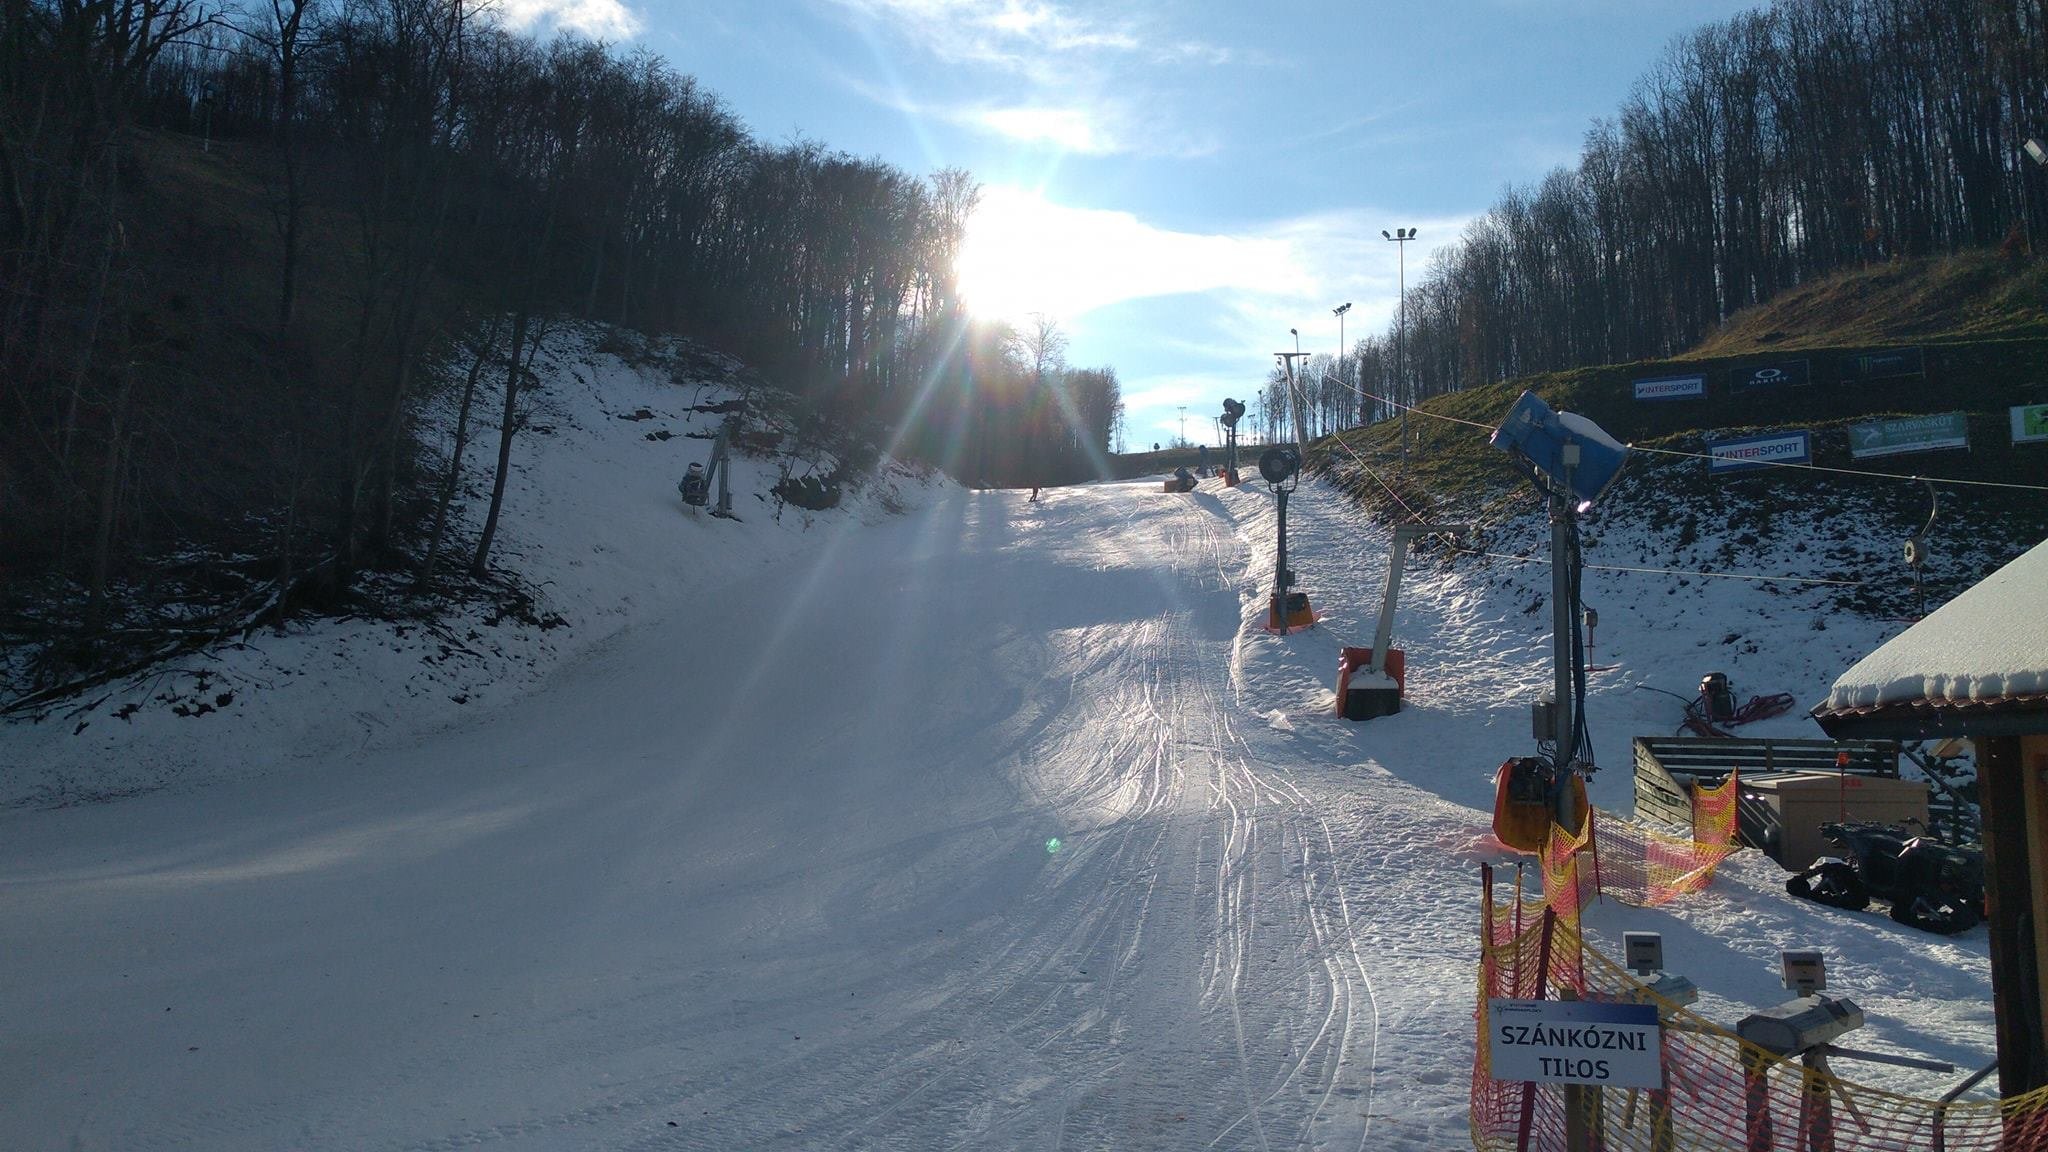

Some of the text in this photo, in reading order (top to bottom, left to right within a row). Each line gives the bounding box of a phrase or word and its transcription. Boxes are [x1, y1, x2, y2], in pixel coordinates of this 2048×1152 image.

[1645, 383, 1699, 394] INTERSPORT
[1749, 376, 1788, 385] OAKLEY
[1726, 442, 1800, 459] INTERSPORT
[1500, 1022, 1647, 1052] SZÁNKÓZNI
[1538, 1057, 1610, 1080] TILOS
